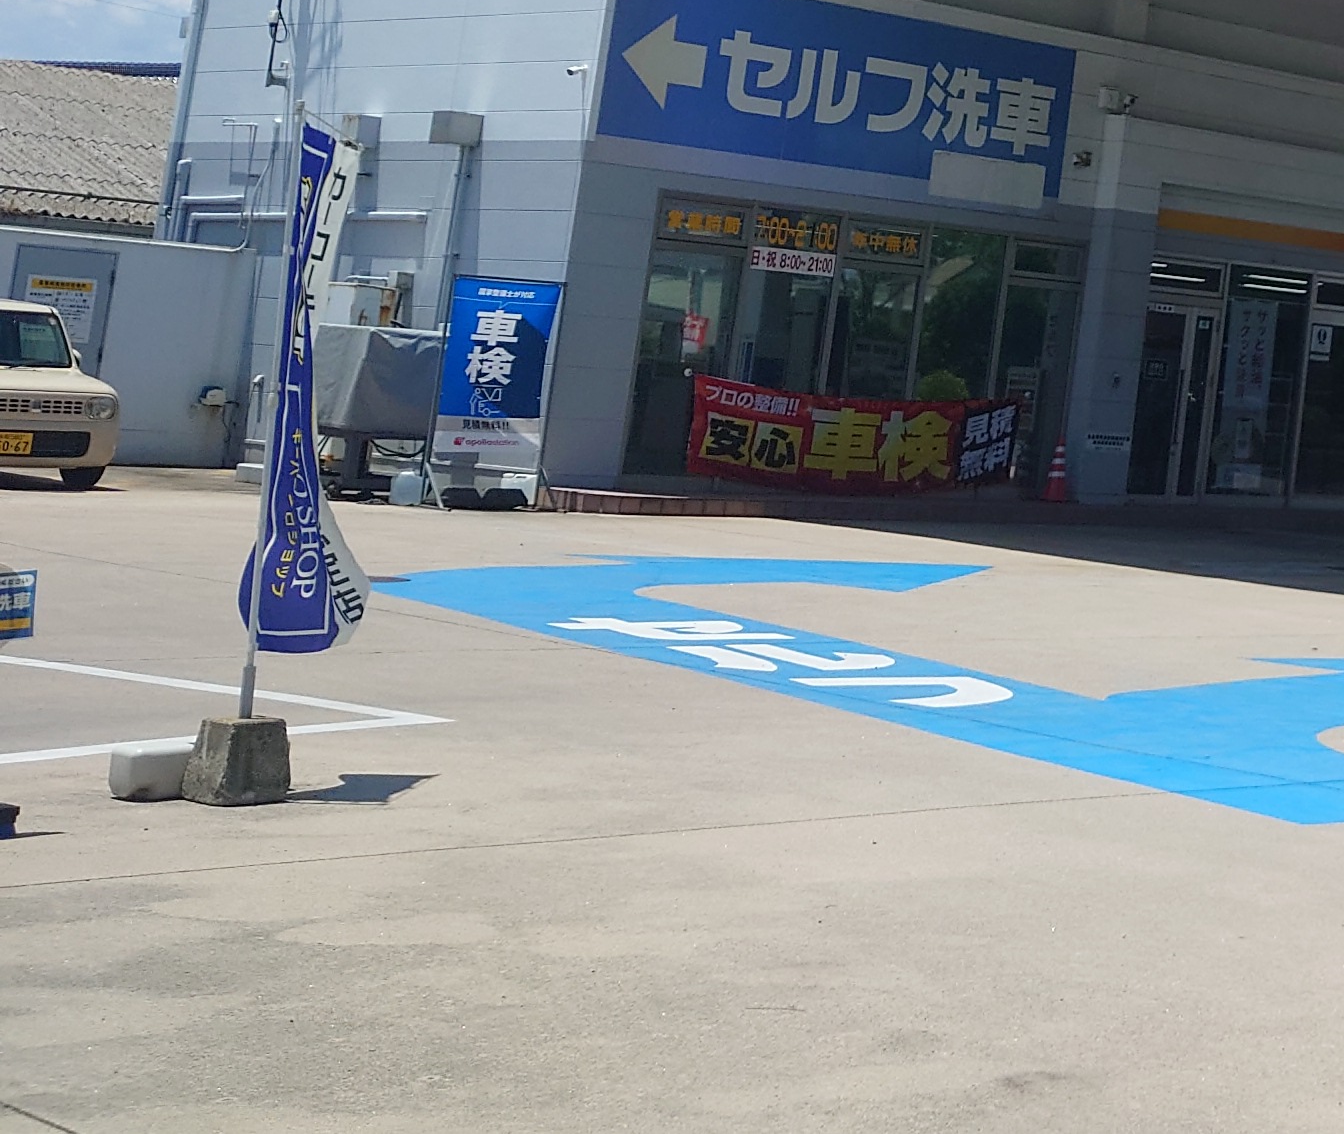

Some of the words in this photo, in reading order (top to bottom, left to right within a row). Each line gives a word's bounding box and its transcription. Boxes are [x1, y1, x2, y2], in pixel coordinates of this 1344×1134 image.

[719, 29, 1057, 156] セルフ洗車
[667, 209, 742, 235] 営業時間
[465, 309, 523, 385] 車検
[704, 384, 800, 416] プロの整備!!
[962, 404, 1017, 448] 見積
[704, 416, 797, 469] 安心
[803, 407, 953, 483] 車検
[957, 437, 1010, 482] 無料
[290, 505, 321, 599] SHOP
